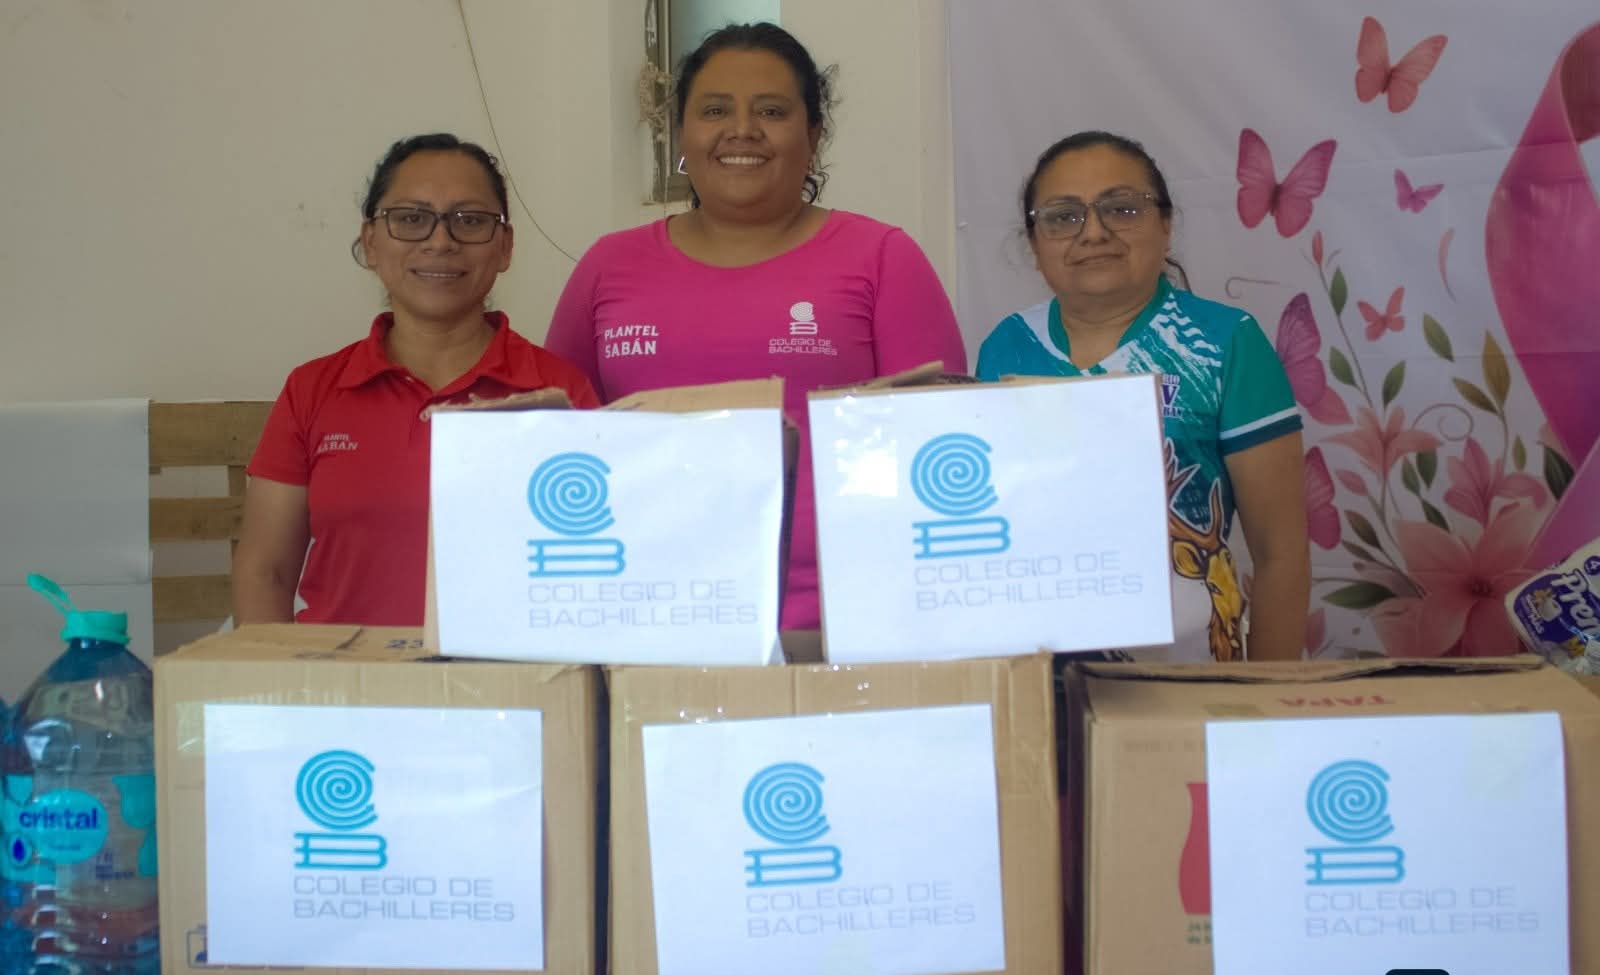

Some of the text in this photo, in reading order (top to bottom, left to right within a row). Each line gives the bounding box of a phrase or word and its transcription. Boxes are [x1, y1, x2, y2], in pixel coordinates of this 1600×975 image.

[604, 325, 659, 341] PLANTEL
[769, 338, 831, 346] COLEGIO DE
[605, 337, 657, 359] SABÁN
[769, 346, 838, 356] BACHILLERES
[915, 551, 1121, 586] COLEGIO DE
[528, 579, 737, 604] COLEGIO DE
[915, 574, 1144, 611] BACHILLERES
[528, 604, 759, 628] BACHILLERES
[19, 806, 98, 831] cristal
[293, 875, 494, 898] COLEGIO DE
[746, 881, 952, 914] COLEGIO DE
[1305, 885, 1517, 912] COLEGIO DE
[293, 898, 515, 922] BACHILLERES
[747, 903, 977, 938] BACHILLERES
[1305, 911, 1540, 937] BACHILLERES
